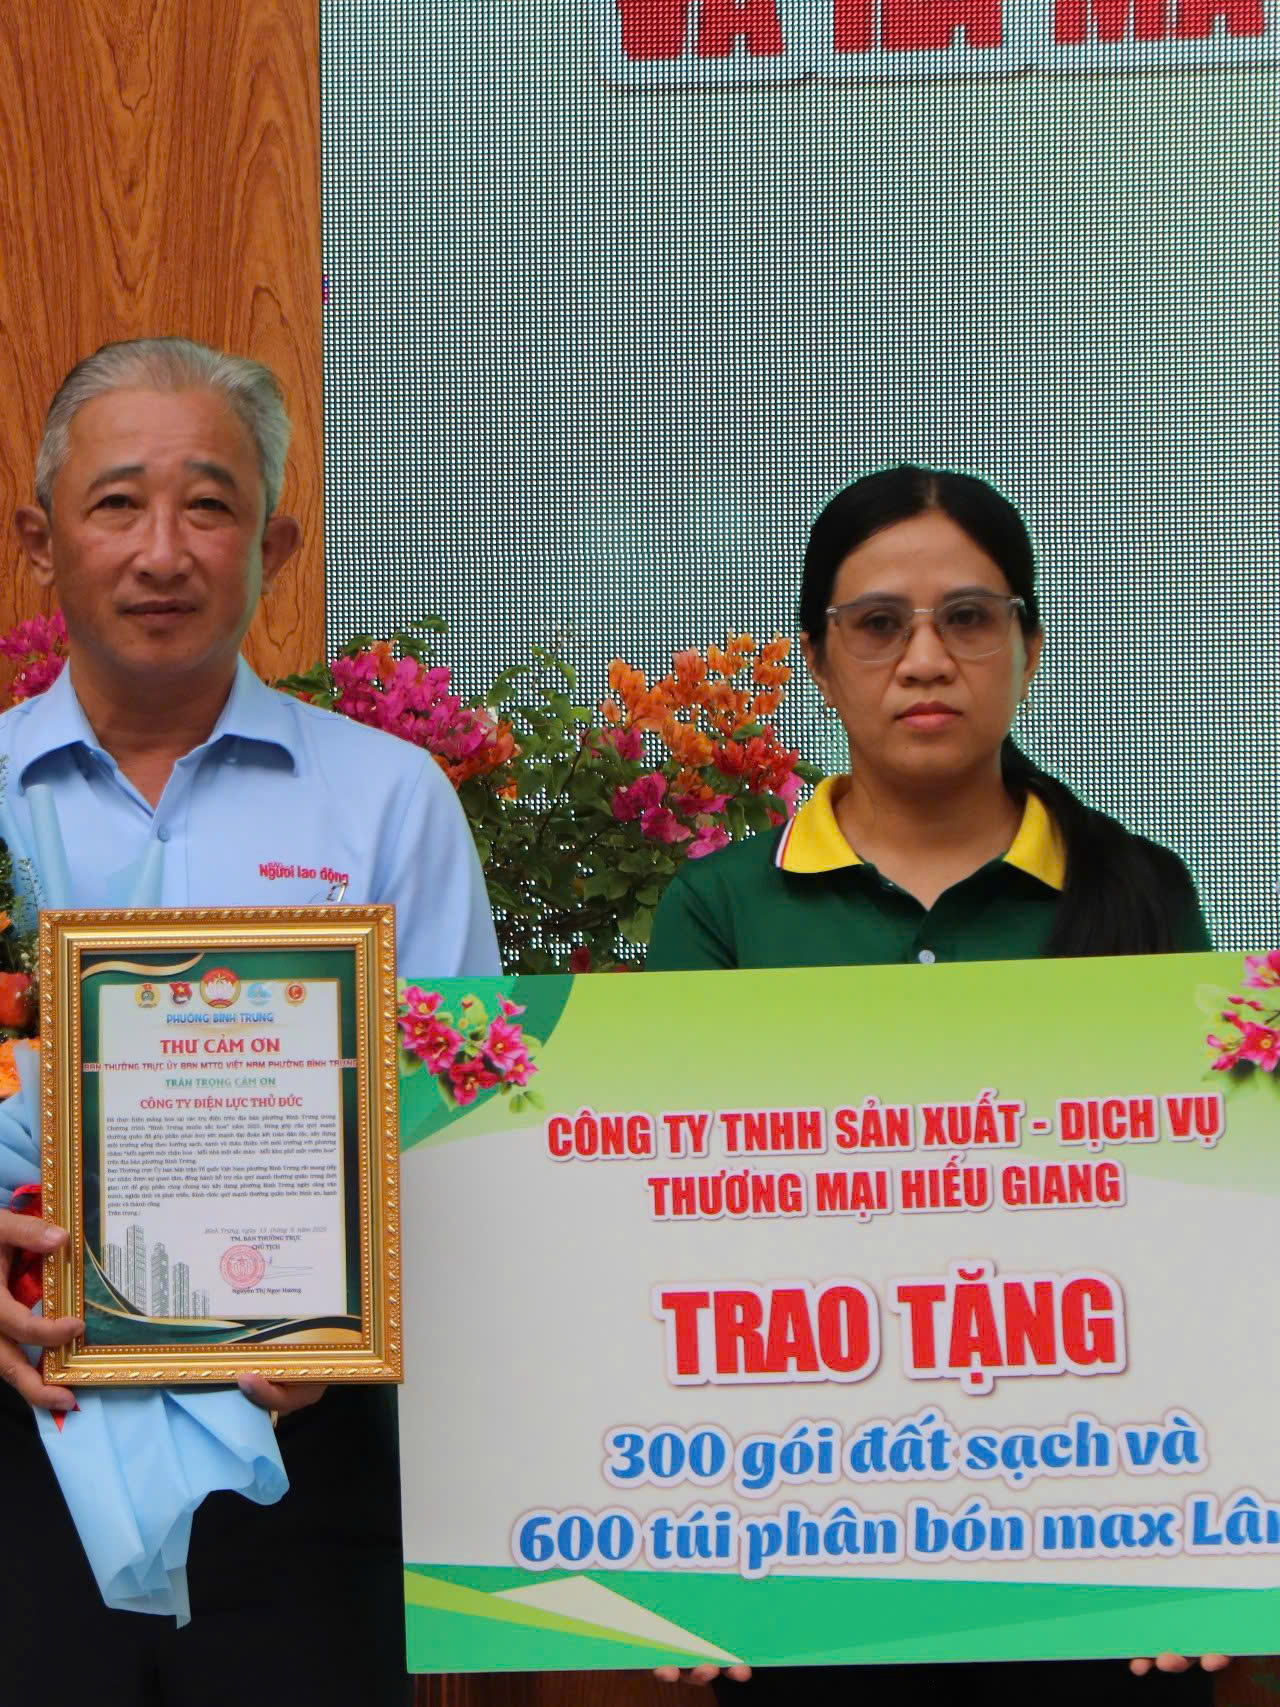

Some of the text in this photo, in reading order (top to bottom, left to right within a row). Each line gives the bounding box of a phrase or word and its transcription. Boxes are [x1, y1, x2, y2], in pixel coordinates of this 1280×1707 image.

[160, 1033, 281, 1054] THƯ CẢM ƠN
[140, 1093, 304, 1112] CÔNG TY ĐIỆN LỰC THỦ ĐỨC
[547, 1090, 1223, 1157] CÔNG TY TNHH SẢN XUẤT - DỊCH VỤ
[647, 1155, 1121, 1218] THƯƠNG MẠI HIẾU GIANG
[660, 1267, 1117, 1385] TRAO TẶNG
[611, 1413, 1200, 1489] 300 gói đất sạch và
[519, 1514, 636, 1562] 600
[651, 1509, 732, 1560] túi
[745, 1506, 899, 1570] phân
[914, 1502, 1019, 1554] bón
[1042, 1510, 1175, 1551] max
